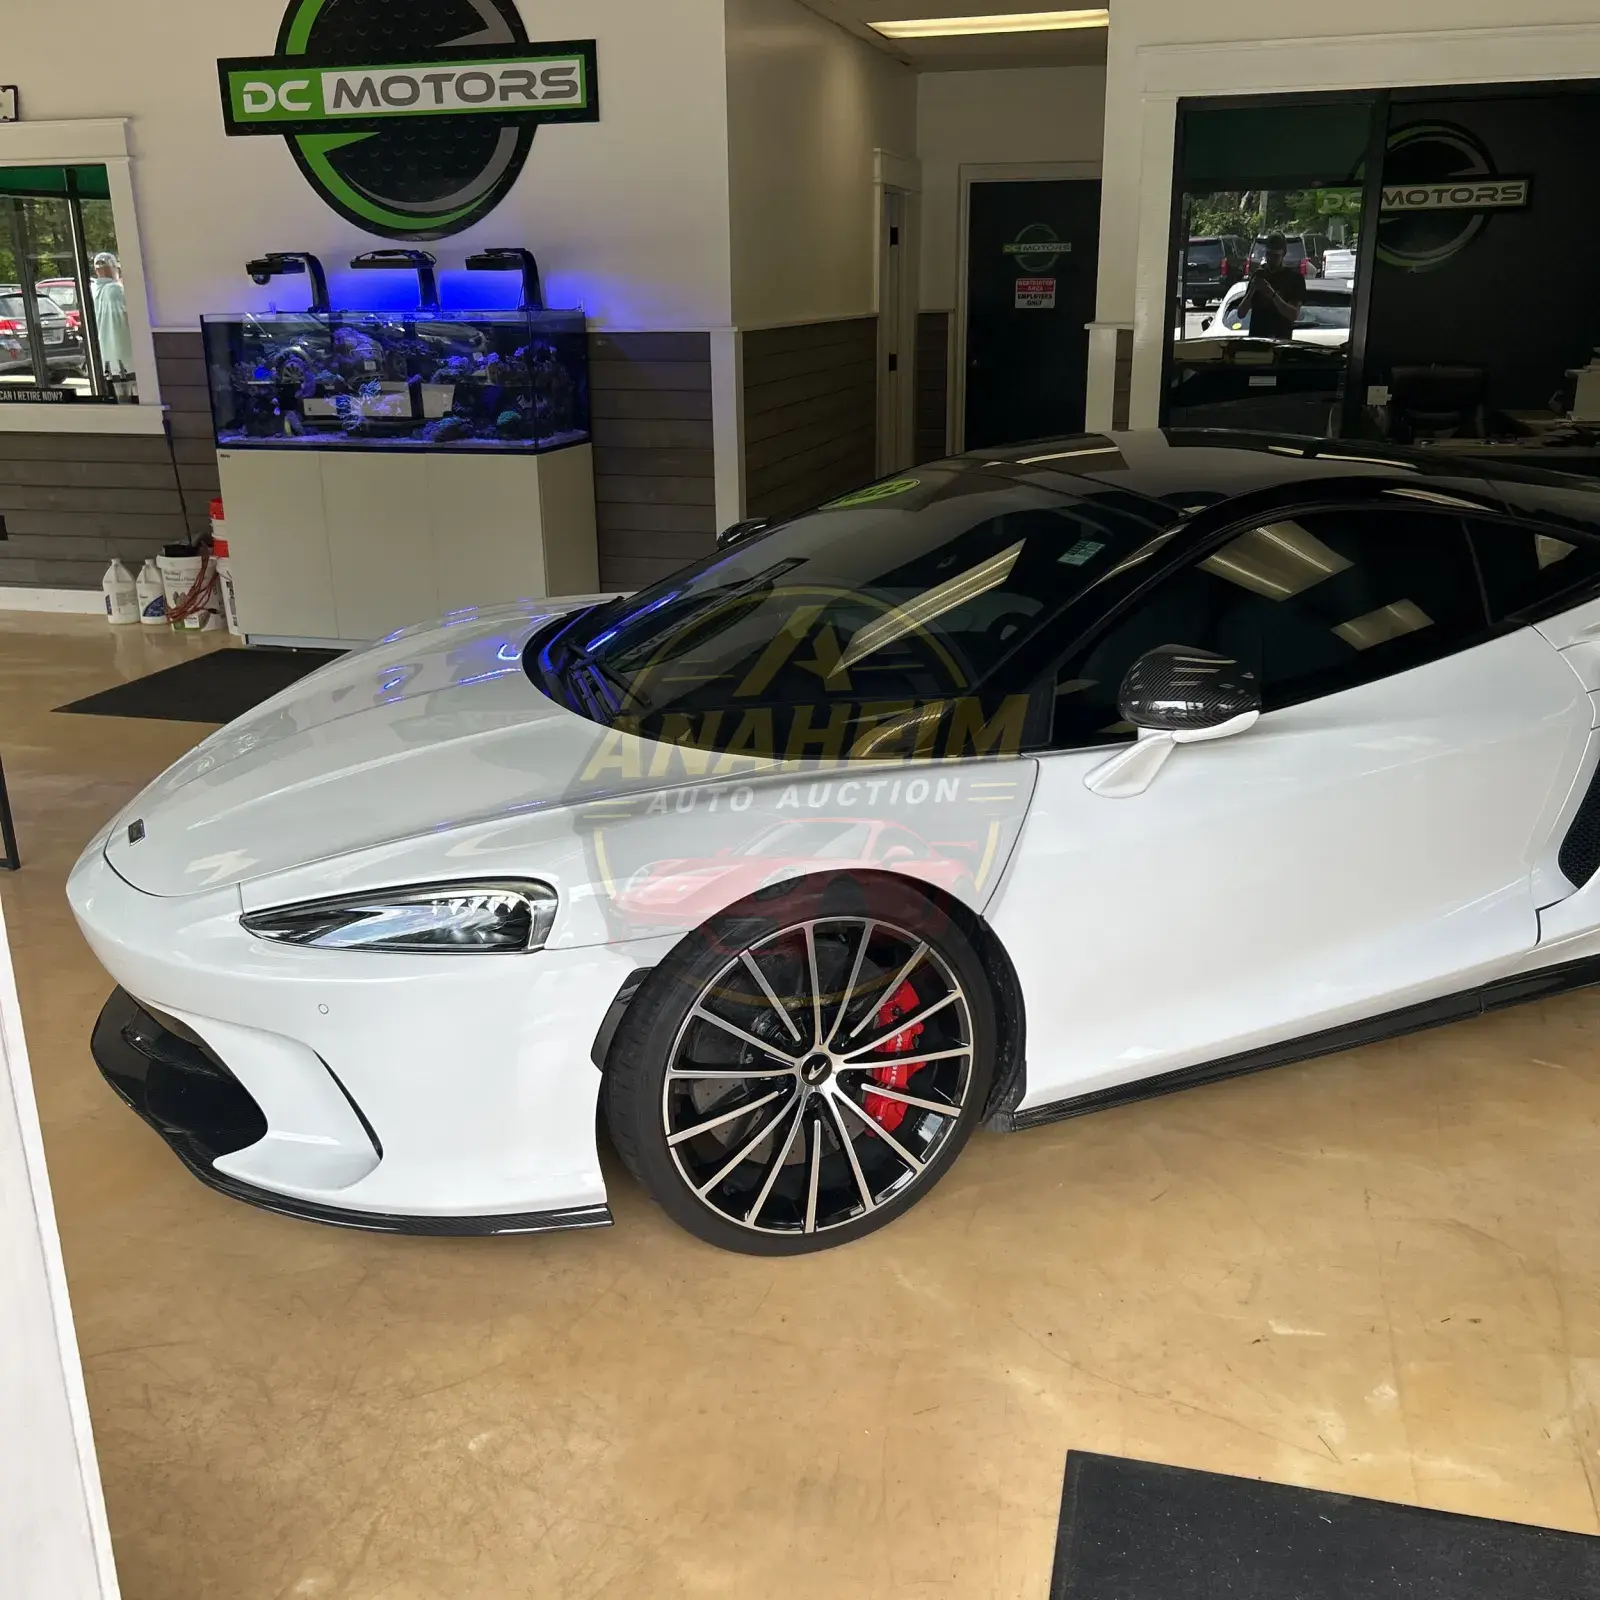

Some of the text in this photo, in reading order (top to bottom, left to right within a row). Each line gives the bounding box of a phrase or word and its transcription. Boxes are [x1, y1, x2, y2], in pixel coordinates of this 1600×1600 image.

[242, 66, 579, 113] DC MOTORS
[1382, 185, 1524, 206] MOTORS
[0, 391, 12, 400] CAN
[17, 391, 41, 400] RETIRE
[42, 391, 63, 401] NOW?
